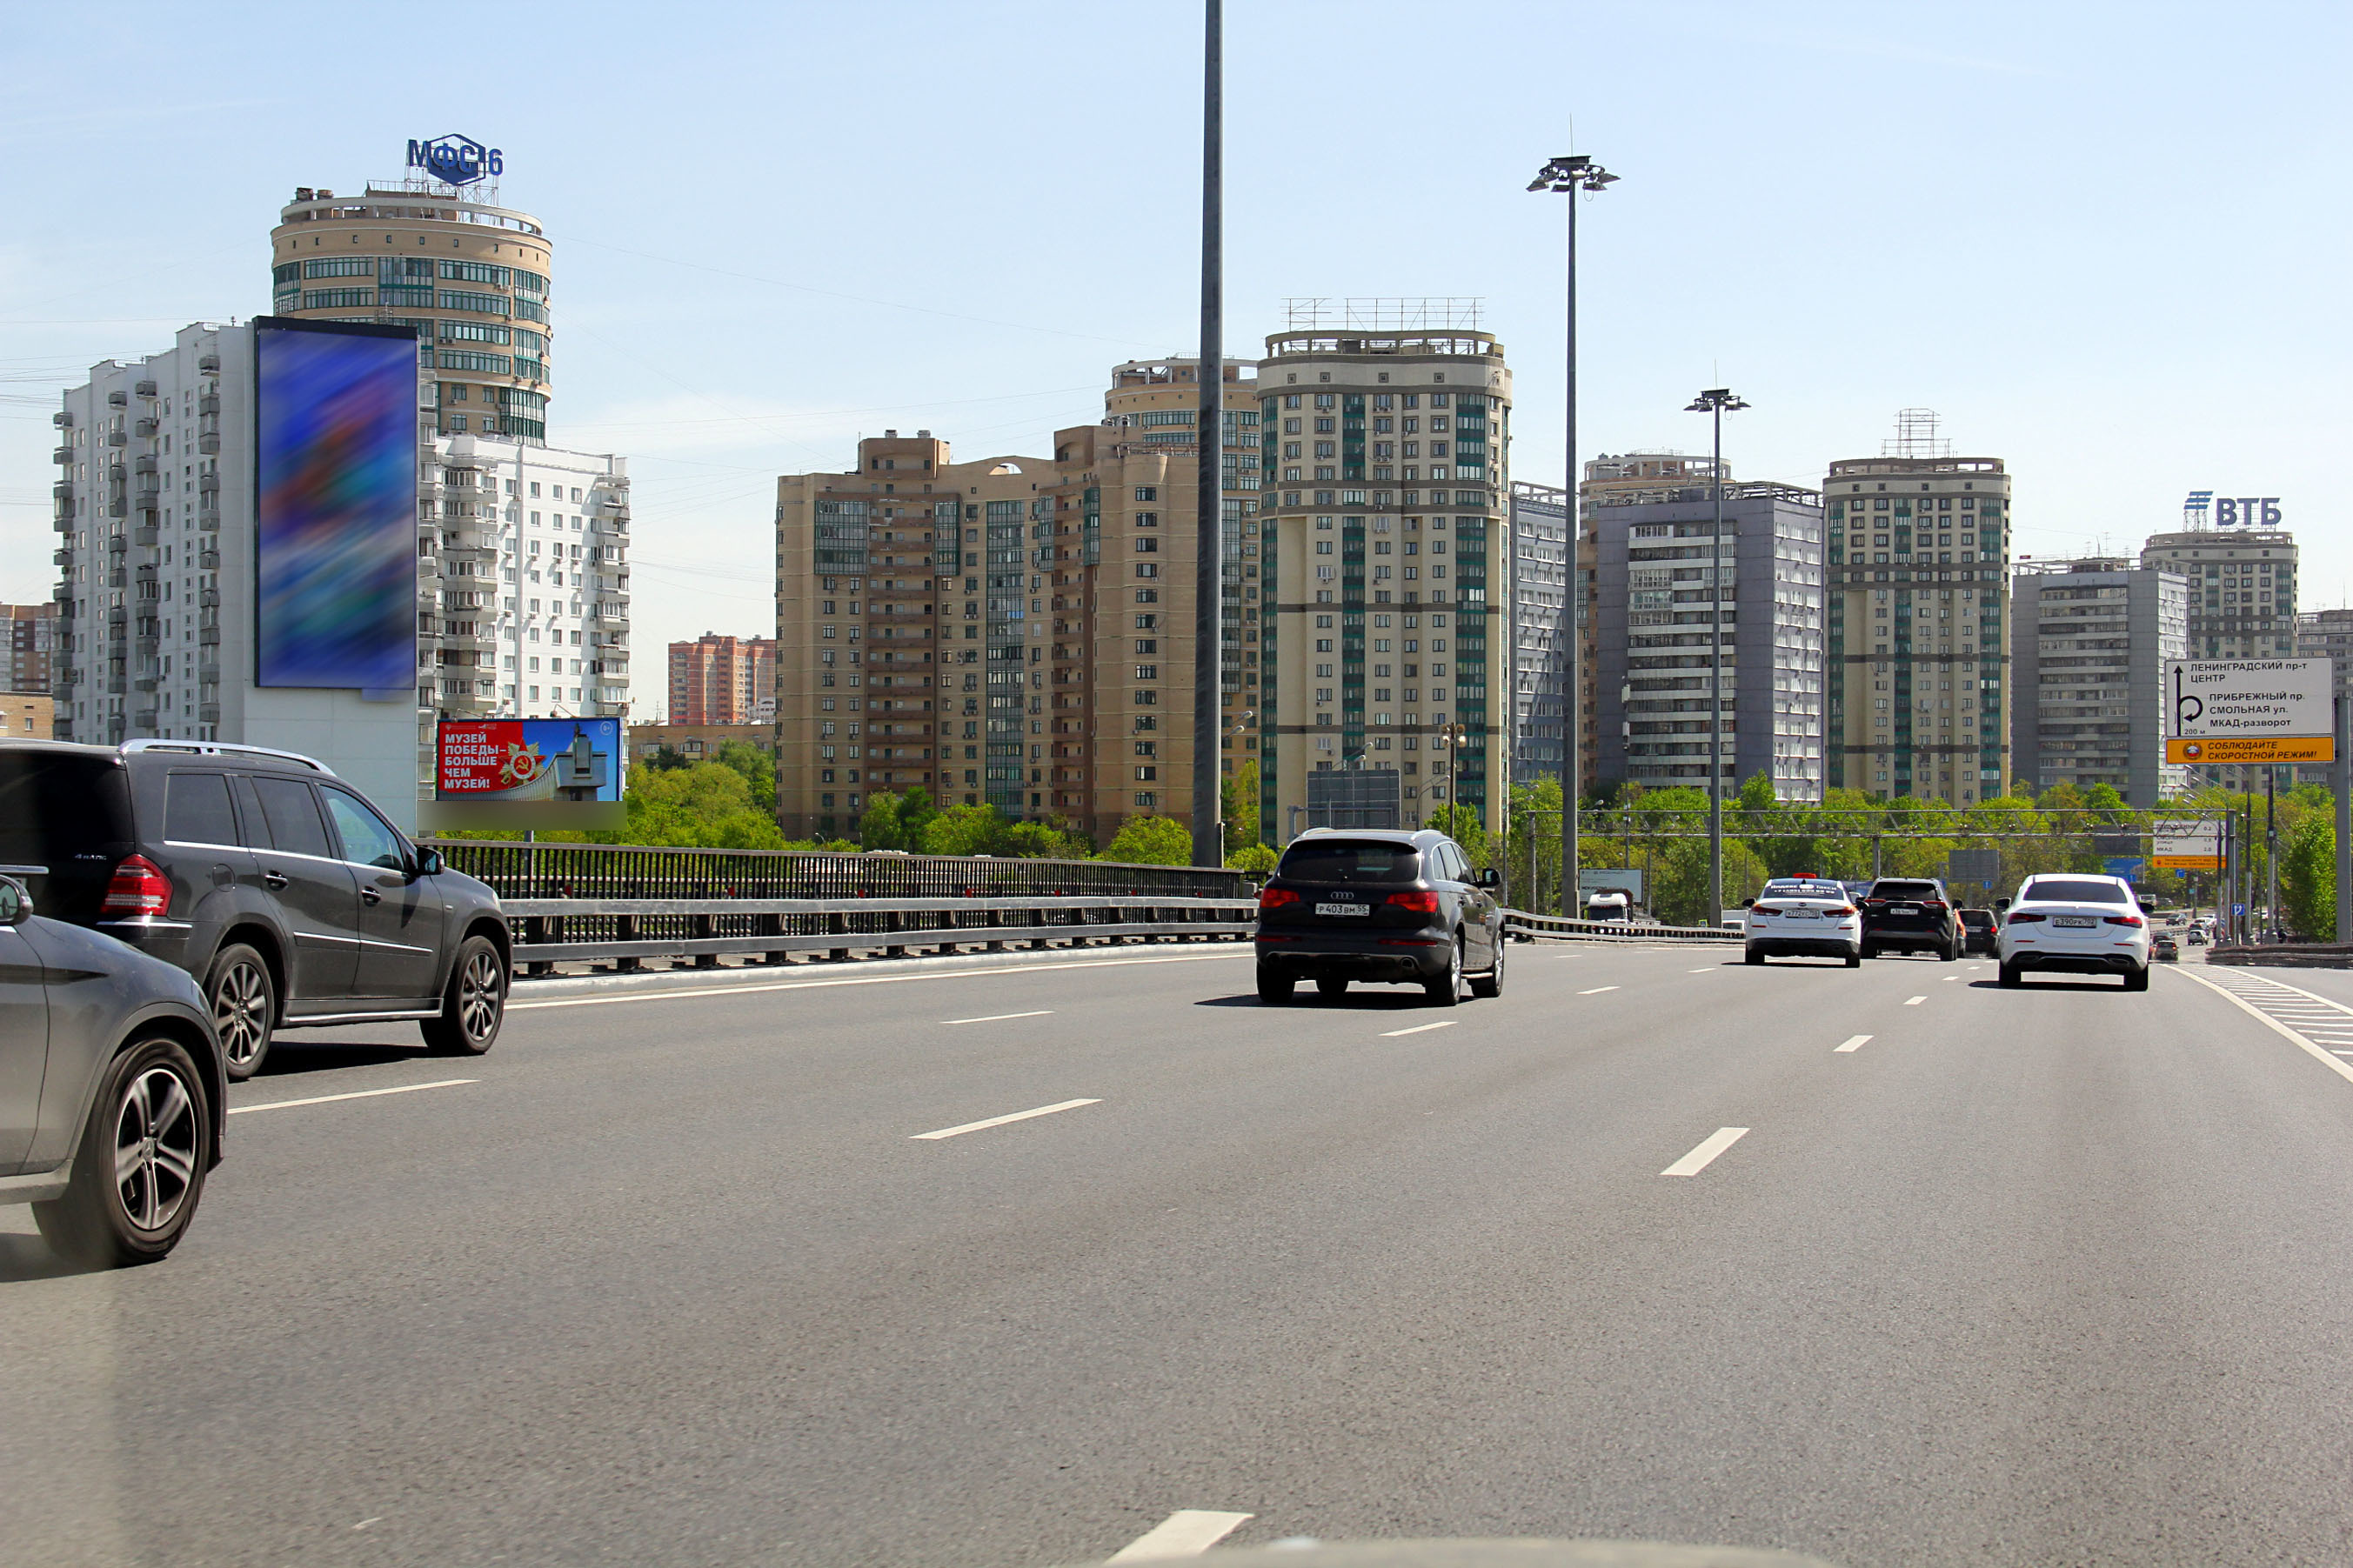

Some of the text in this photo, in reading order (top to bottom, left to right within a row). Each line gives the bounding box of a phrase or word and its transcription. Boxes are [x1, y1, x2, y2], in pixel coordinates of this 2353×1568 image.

[2216, 497, 2282, 525] ВТБ
[2190, 662, 2283, 672] ЛЕНИНГРАДСКИЙ
[2190, 674, 2225, 684] ЦЕНТР
[2209, 691, 2305, 702] ПРИБРЕЖНЫЙ пр.
[2209, 705, 2289, 715] СМОЛЬНАЯ ул.
[2209, 719, 2291, 728] МКАД-разворот
[445, 731, 487, 744] МУЗЕЙ
[2208, 741, 2278, 751] СОБЛЮДАЙТЕ
[2208, 751, 2316, 760] СКОРОСТНОЙ РЕЖИМ!
[445, 757, 498, 766] БОЛЬШЕ
[445, 768, 471, 777] ЧЕМ
[445, 777, 490, 789] МУЗЕЙ!
